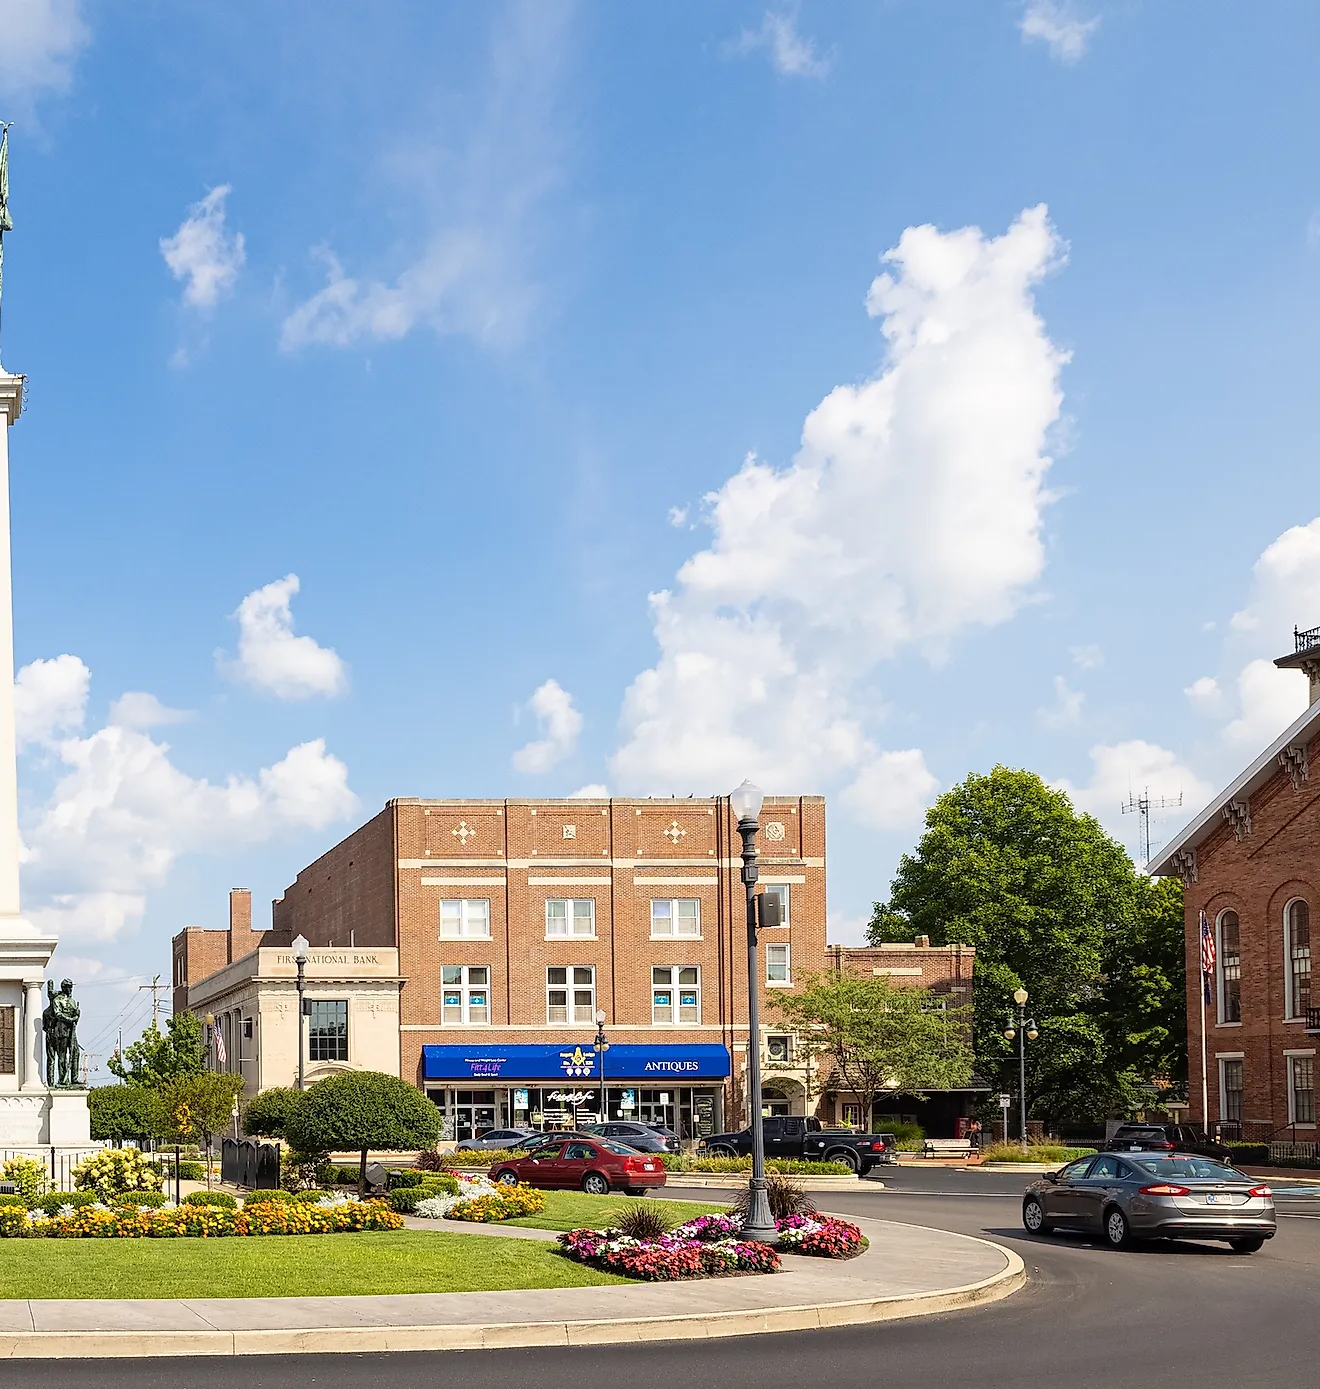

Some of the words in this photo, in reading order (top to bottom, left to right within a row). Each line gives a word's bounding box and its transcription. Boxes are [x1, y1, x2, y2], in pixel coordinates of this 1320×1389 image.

[277, 955, 296, 964] FIRS
[305, 955, 348, 964] NATIONAL
[353, 955, 378, 964] BANK
[644, 1061, 699, 1072] ANTIQUES
